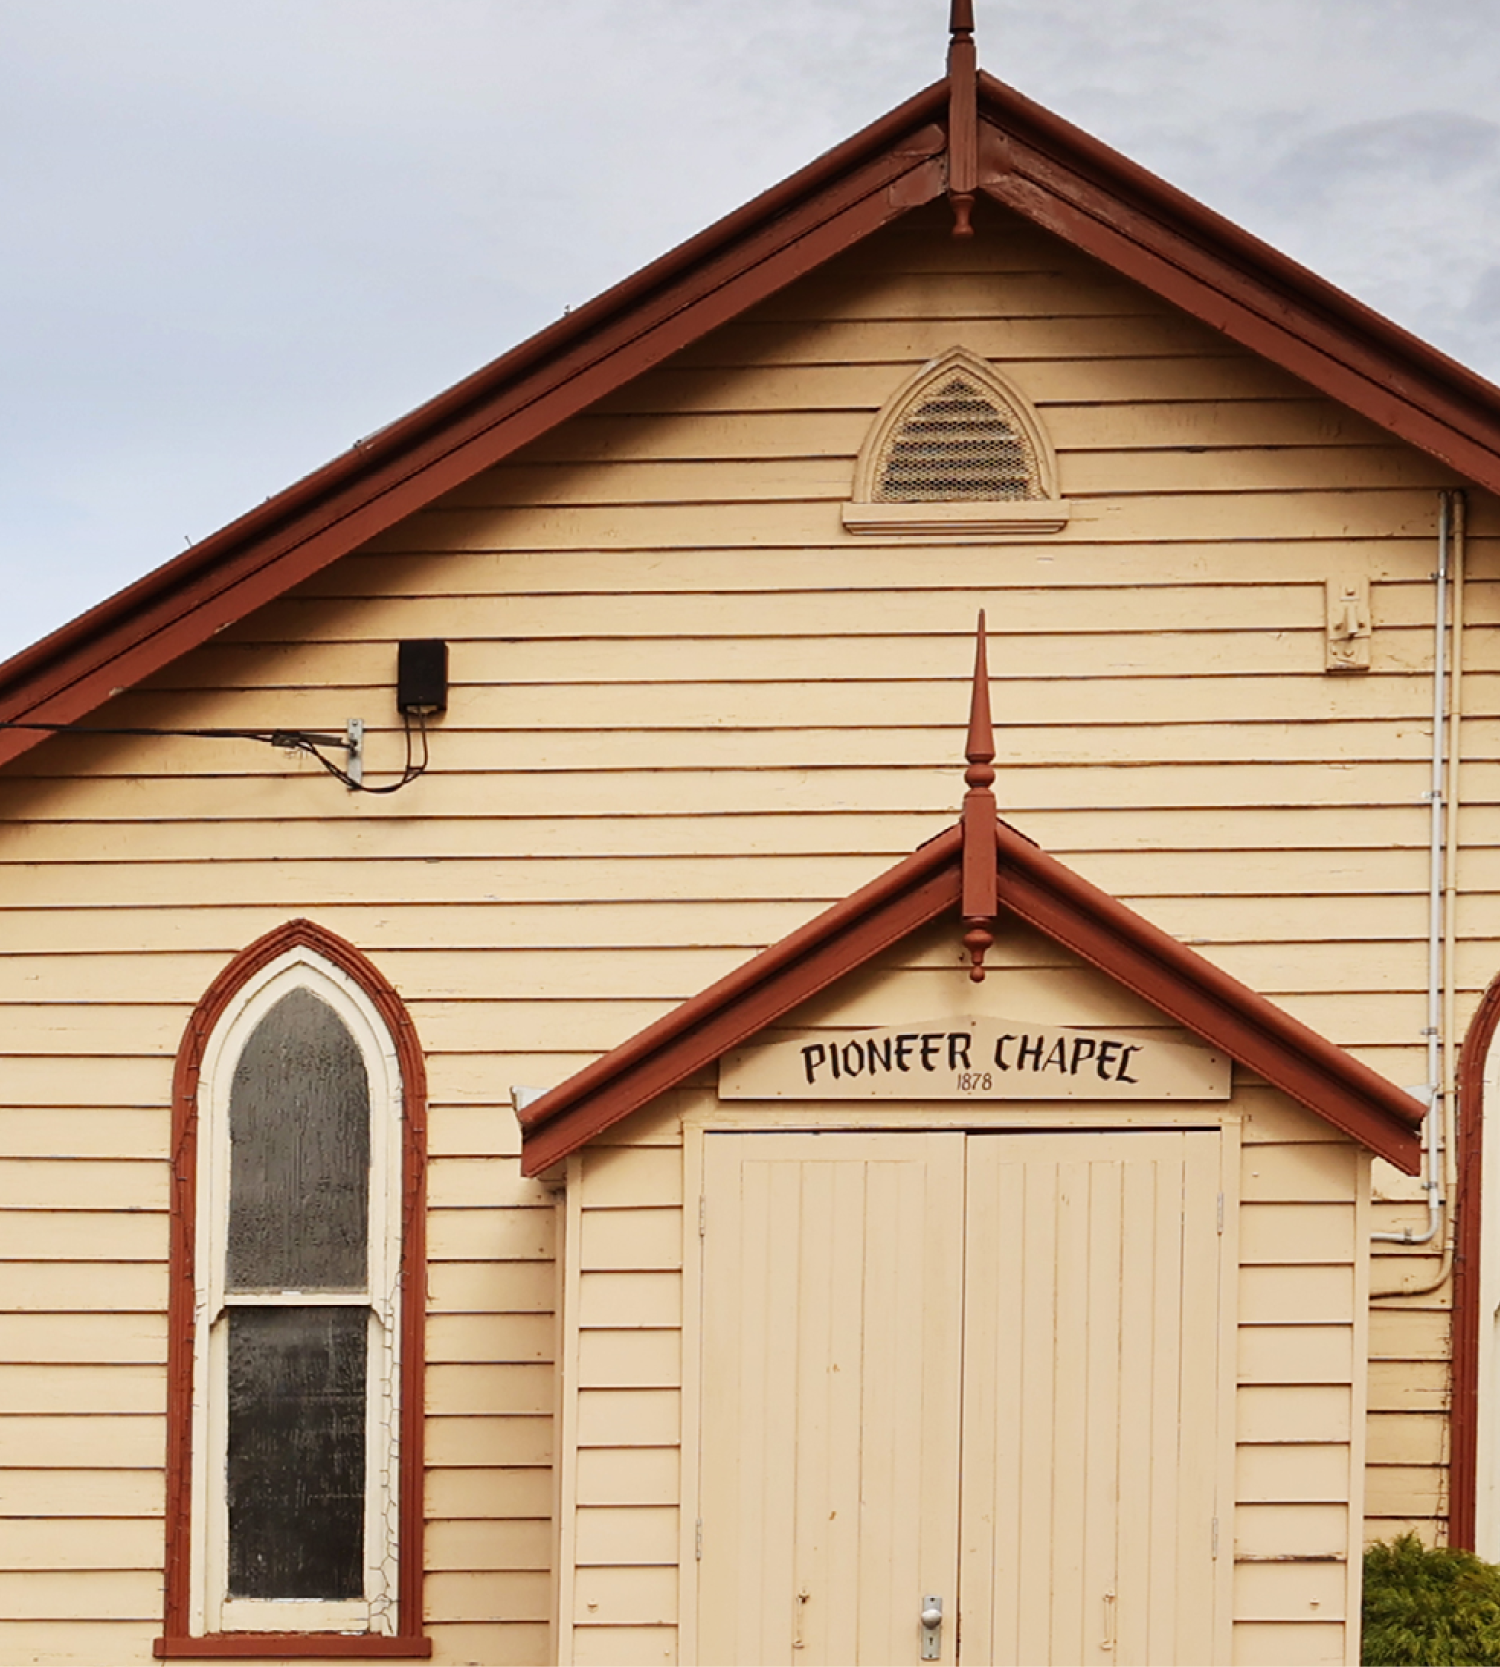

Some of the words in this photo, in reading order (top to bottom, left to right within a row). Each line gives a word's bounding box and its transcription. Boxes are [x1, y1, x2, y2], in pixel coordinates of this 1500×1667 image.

[801, 1032, 974, 1085] PIONEER
[994, 1034, 1144, 1085] CHAPEL
[956, 1072, 993, 1092] 1878
